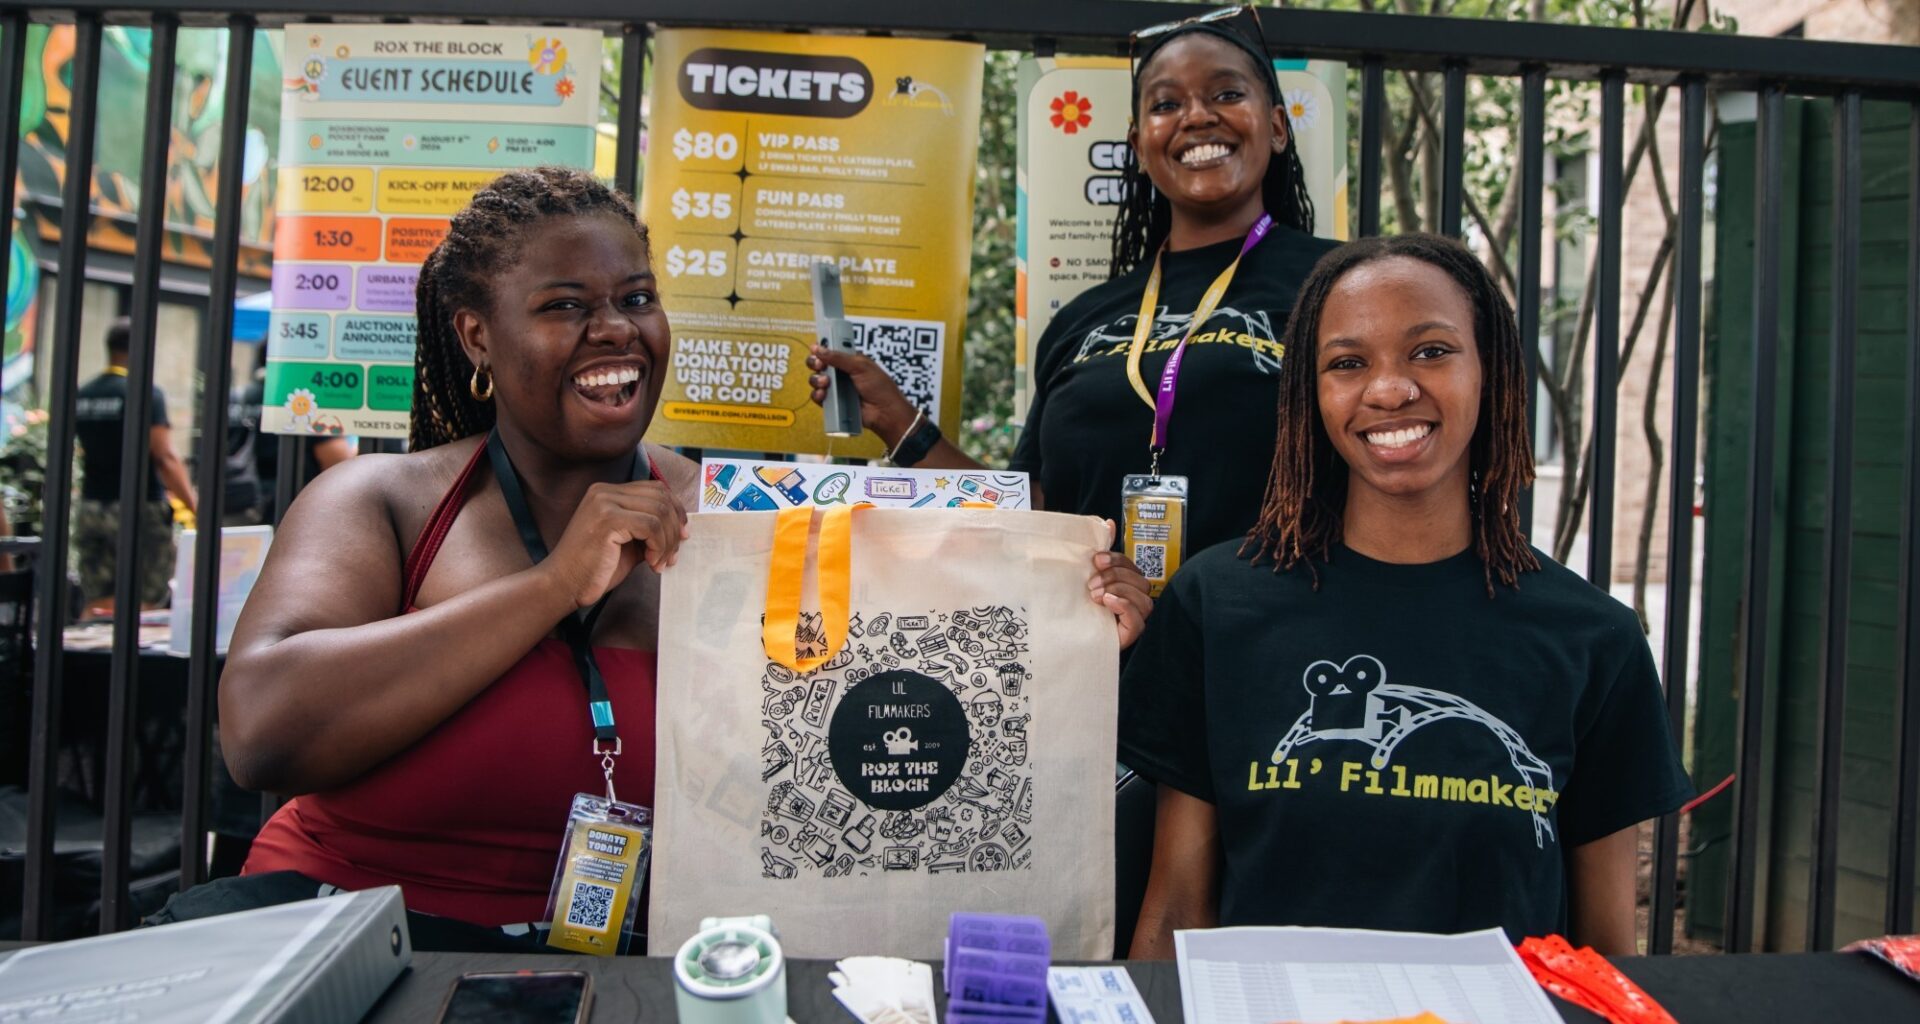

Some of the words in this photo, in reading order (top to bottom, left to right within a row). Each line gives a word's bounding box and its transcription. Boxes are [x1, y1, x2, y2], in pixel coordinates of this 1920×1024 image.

[374, 41, 409, 55] ROX
[411, 42, 443, 55] THE
[447, 43, 503, 56] BLOCK
[340, 68, 413, 91] EVENT
[420, 69, 534, 95] SCHEDULE
[686, 63, 866, 103] TICKETS
[536, 139, 556, 147] 4:00
[672, 128, 738, 161] $80
[758, 133, 789, 149] VIP
[792, 134, 841, 152] PASS
[767, 152, 795, 161] DRINK
[843, 156, 885, 167] CATERED
[770, 163, 799, 173] SWAG
[822, 166, 856, 176] PHILLY
[855, 168, 888, 178] TREATS
[302, 176, 354, 193] 12:00
[387, 180, 449, 192] KICK-OFF
[671, 188, 732, 220] $35
[757, 190, 794, 206] FUN
[797, 192, 845, 209] PASS
[755, 208, 834, 220] COMPLIMENTARY
[834, 211, 866, 223] PHILLY
[867, 213, 901, 224] TREATS
[1049, 219, 1098, 228] Welcome
[1099, 219, 1107, 228] to
[391, 228, 443, 238] POSITIVE
[754, 219, 797, 230] CATERED
[798, 222, 825, 231] PLATE
[838, 224, 867, 233] DRINK
[868, 226, 901, 236] TICKET
[314, 230, 353, 247] 1:30
[1049, 232, 1066, 241] and
[1067, 232, 1113, 243] family-frie
[665, 246, 727, 277] $25
[838, 255, 897, 275] PLATE
[1066, 258, 1081, 267] NO
[1085, 259, 1112, 268] SMO
[295, 274, 339, 290] 2:00
[367, 274, 407, 285] URBAN
[747, 269, 766, 278] FOR
[767, 270, 797, 280] THOSE
[852, 275, 866, 284] TO
[867, 277, 915, 288] PURCHASE
[1049, 272, 1080, 283] space.
[1082, 271, 1109, 281] Pleas
[747, 281, 761, 290] ON
[762, 282, 781, 291] SITE
[279, 322, 318, 339] 3:45
[345, 321, 403, 332] AUCTION
[342, 332, 418, 344] ANNOUNCE
[1106, 327, 1286, 359] Flmmakers
[677, 337, 733, 355] MAKE
[736, 341, 791, 359] YOUR
[673, 353, 789, 374] DONATIONS
[310, 371, 359, 389] 4:00
[376, 375, 408, 387] ROLL
[676, 368, 735, 386] USING
[739, 373, 784, 390] THIS
[685, 384, 714, 402] QR
[716, 387, 772, 404] CODE
[353, 420, 391, 430] TICKETS
[393, 422, 407, 431] ON
[1137, 503, 1167, 511] DONATE
[1138, 511, 1165, 519] TODAY!
[868, 703, 931, 719] FILMMAKERS
[924, 742, 941, 750] 2009
[861, 761, 900, 777] ROX
[904, 761, 939, 776] THE
[1247, 757, 1323, 791] Lil'
[870, 777, 930, 794] BLOCK
[588, 830, 627, 846] DONATE
[588, 841, 622, 856] TODAY!
